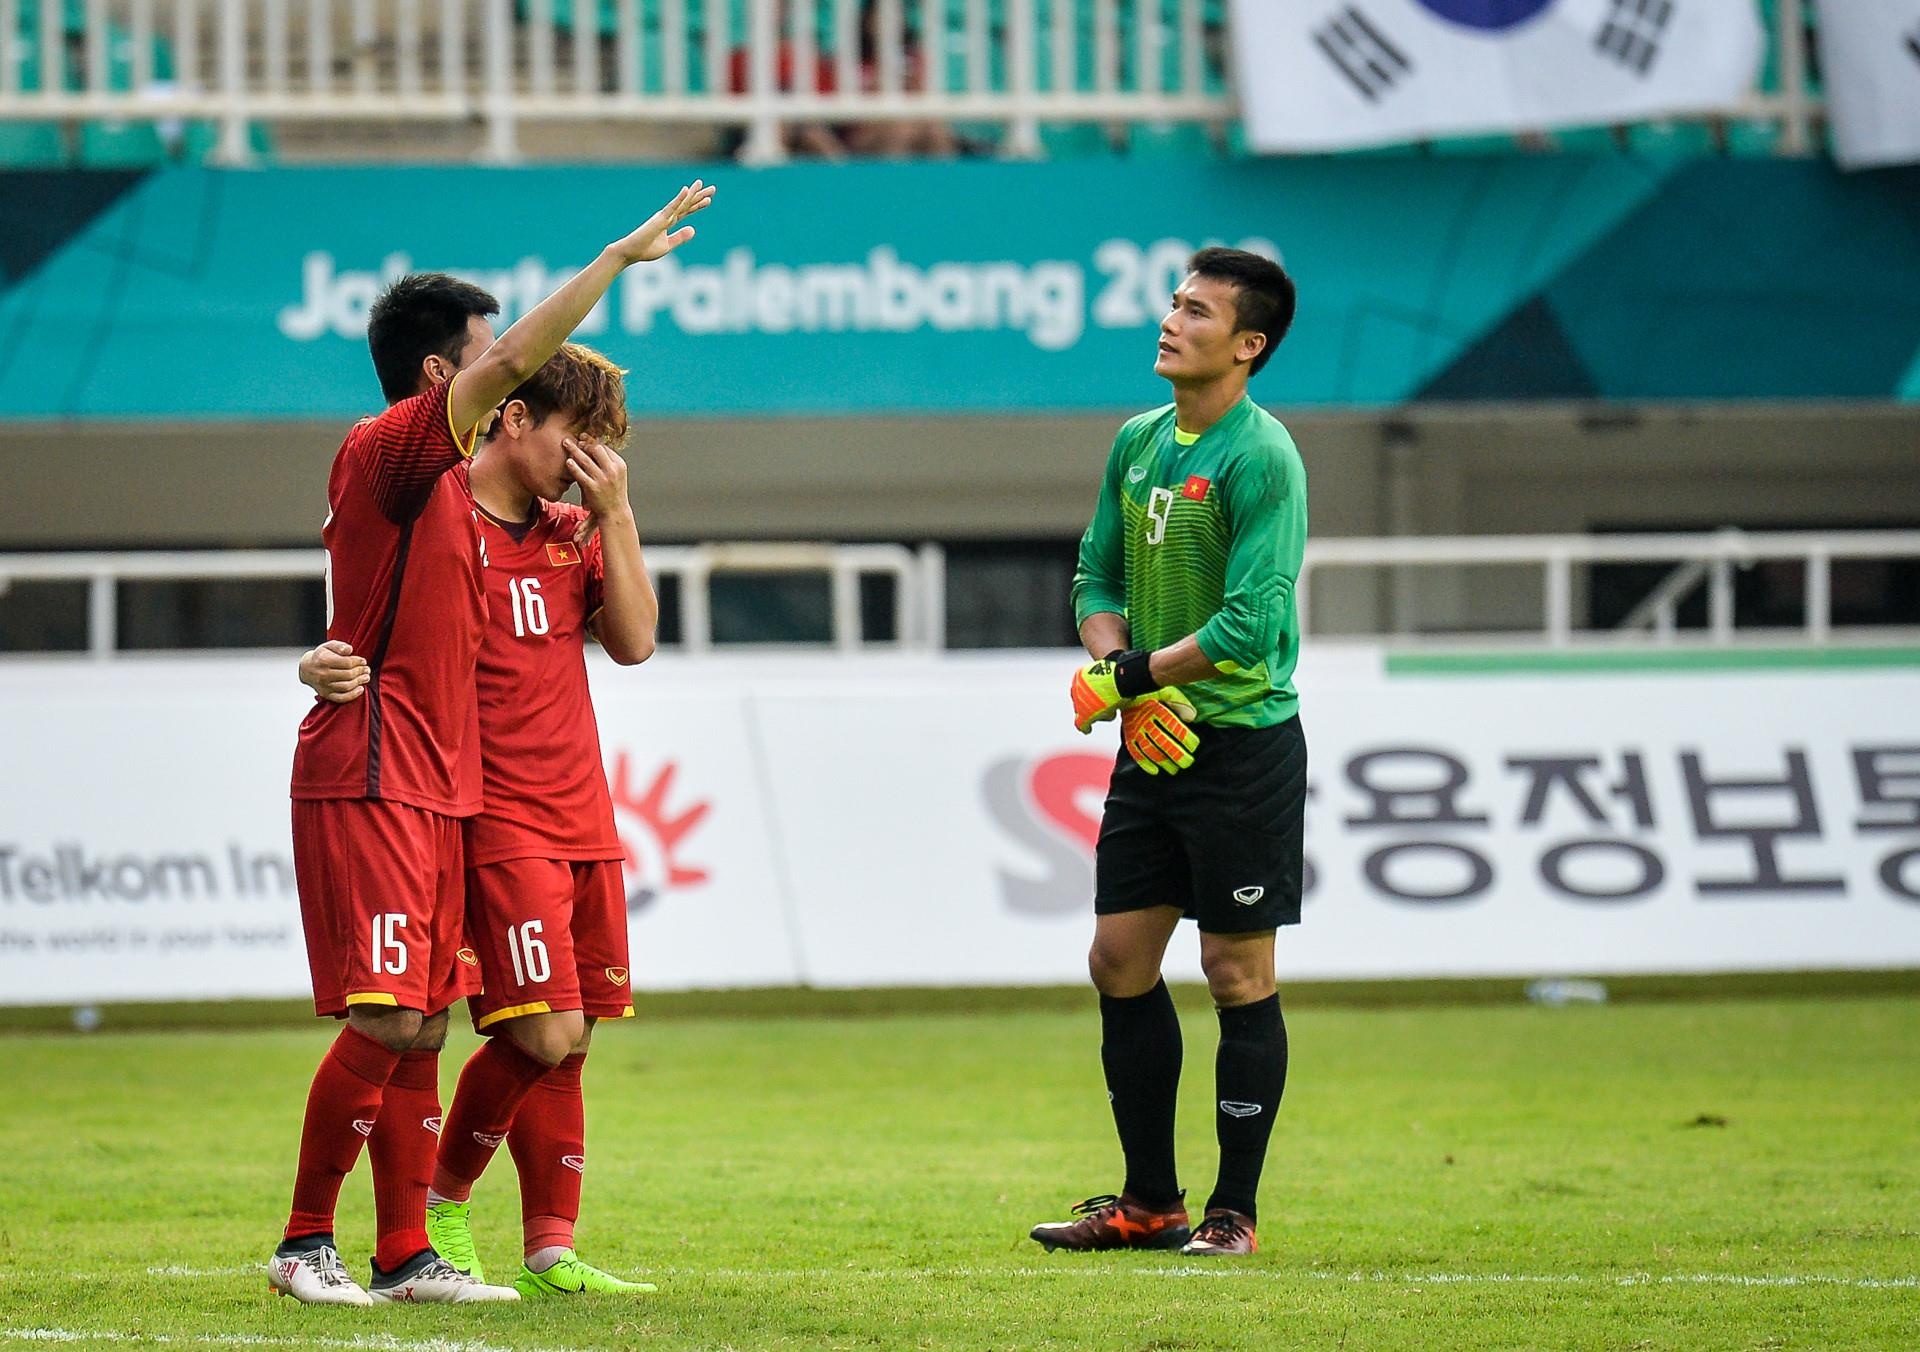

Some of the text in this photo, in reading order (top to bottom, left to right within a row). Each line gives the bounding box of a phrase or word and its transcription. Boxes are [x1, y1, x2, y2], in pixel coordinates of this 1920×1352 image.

[622, 245, 1085, 351] Palembang
[1093, 237, 1284, 328] 20
[508, 577, 549, 637] 16
[1300, 747, 1920, 904] 용정보
[0, 842, 293, 902] Telkom In
[372, 913, 407, 975] 15
[507, 919, 551, 987] 16
